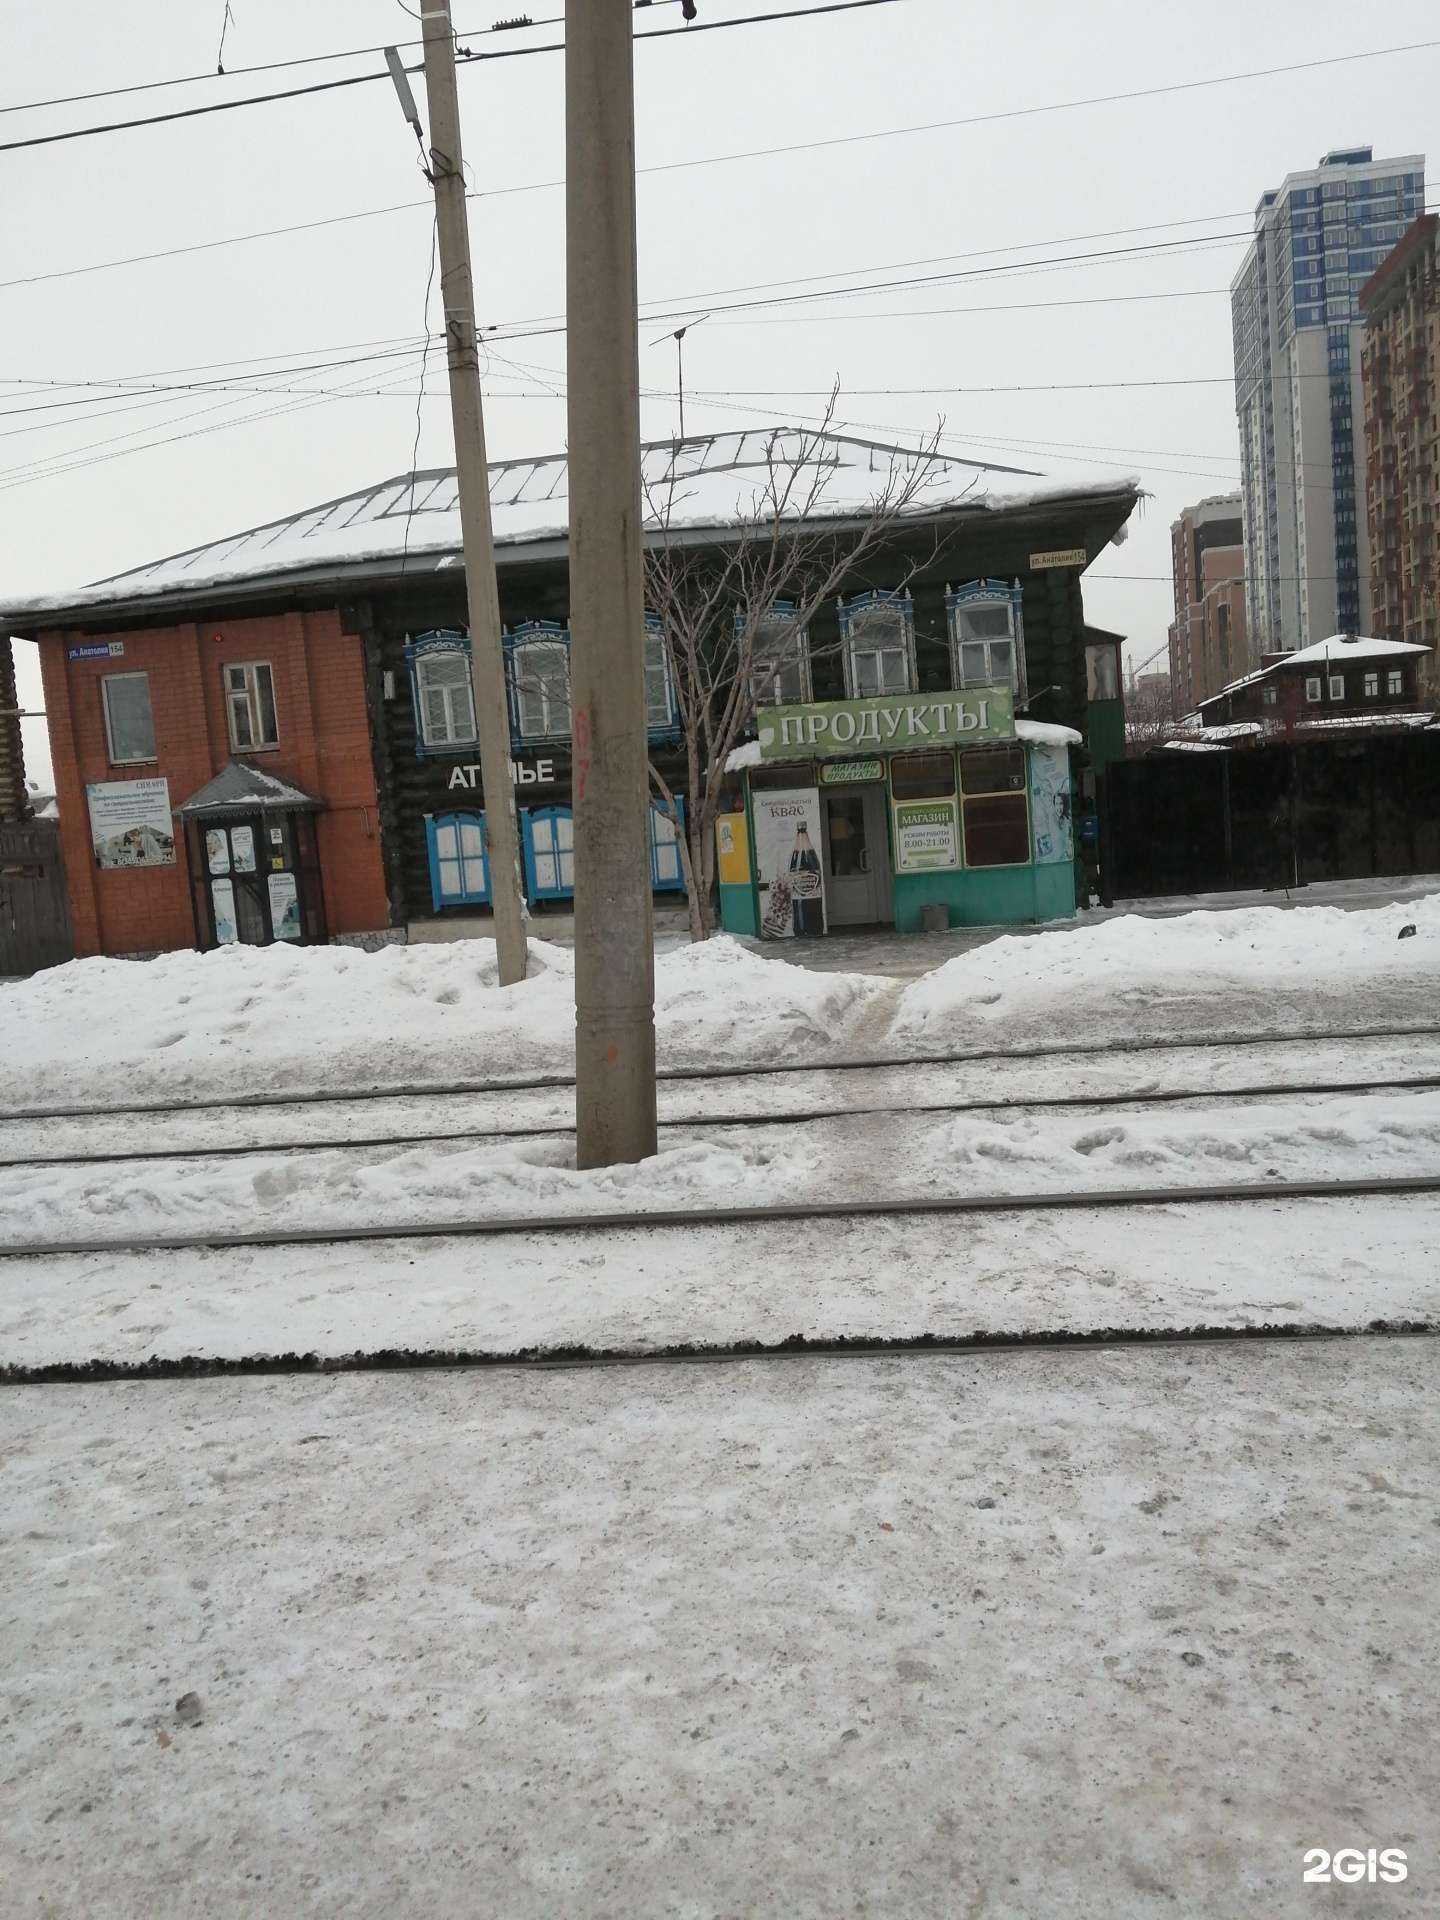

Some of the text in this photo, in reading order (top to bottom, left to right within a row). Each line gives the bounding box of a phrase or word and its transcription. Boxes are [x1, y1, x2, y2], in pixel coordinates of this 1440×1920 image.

[779, 700, 993, 746] ПРОДУКТЫ
[448, 759, 555, 790] АТЬЕ
[902, 812, 949, 825] МАГАЗИН
[904, 838, 950, 848] 8.00-21.00
